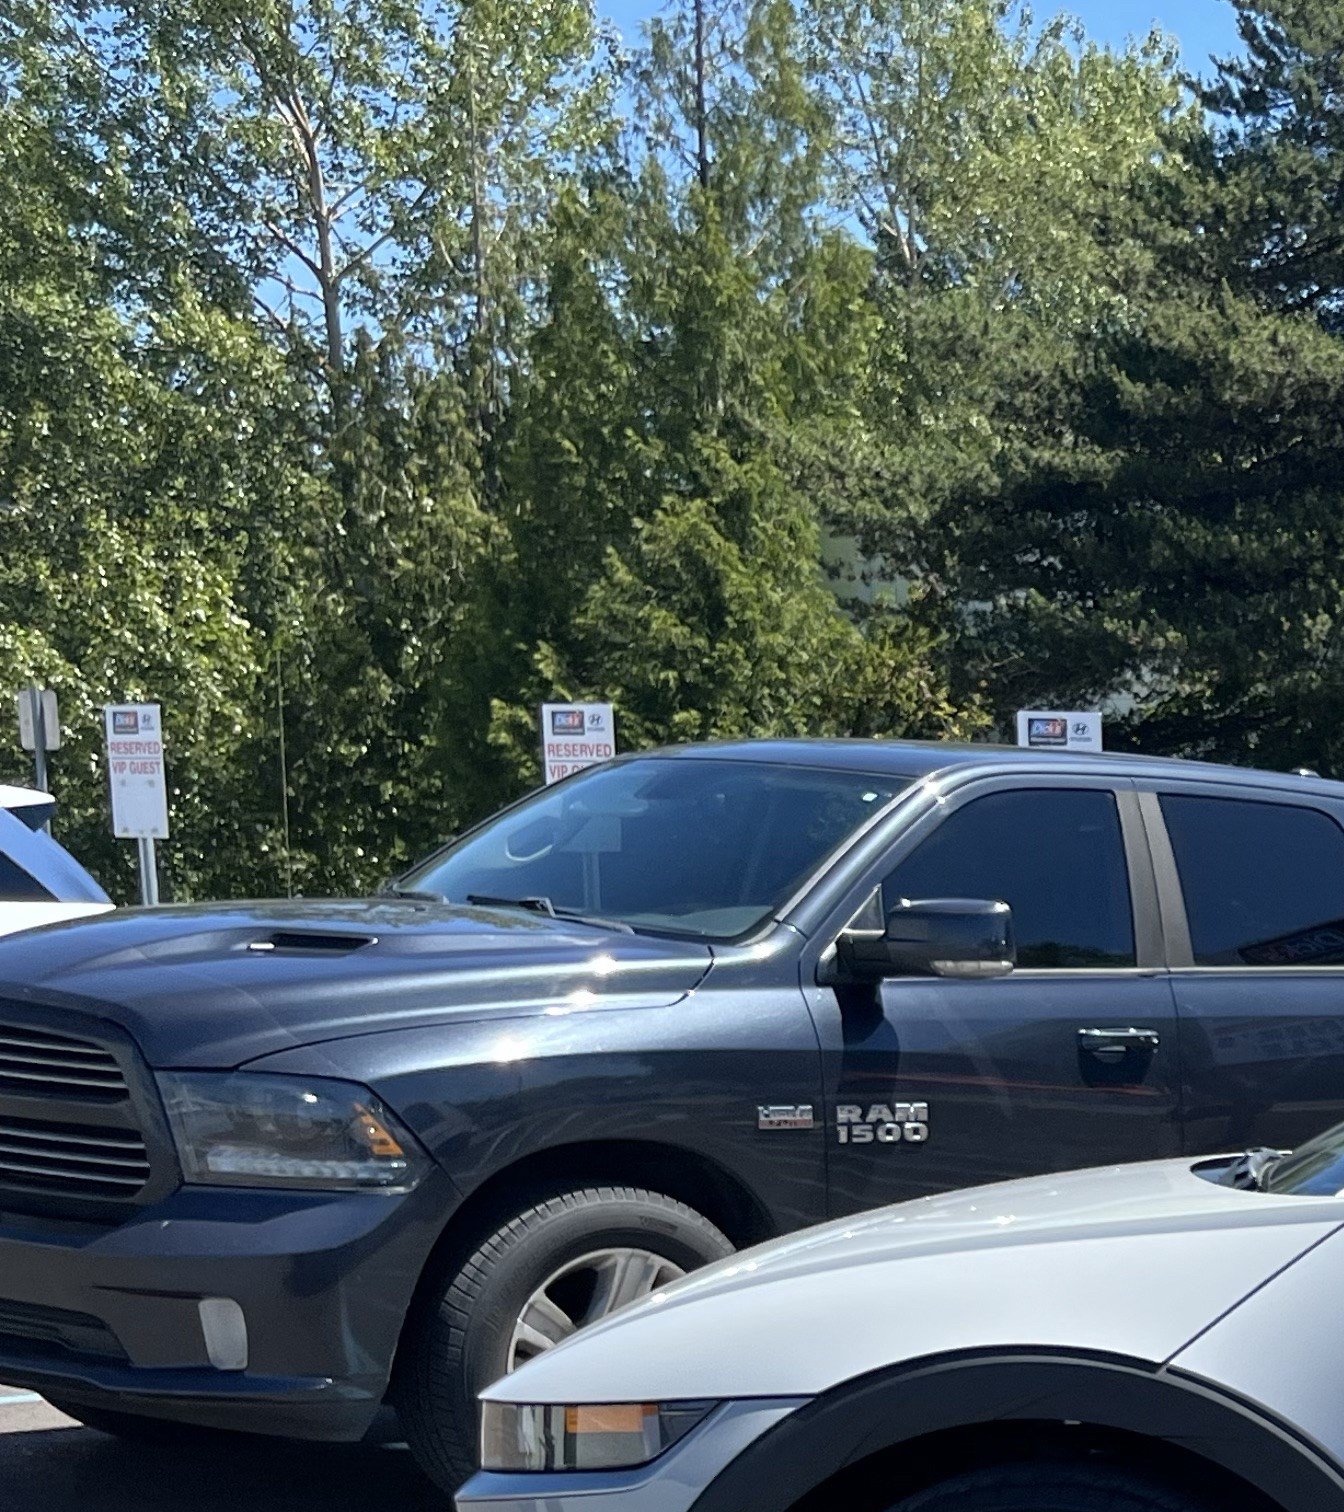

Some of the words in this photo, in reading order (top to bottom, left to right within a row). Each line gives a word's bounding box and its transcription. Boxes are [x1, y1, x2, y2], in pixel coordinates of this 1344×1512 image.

[110, 741, 160, 755] RESERVED
[547, 743, 612, 757] RESERVED
[113, 762, 127, 774] VIP
[130, 762, 160, 774] GUEST
[550, 765, 568, 779] VIP
[836, 1102, 929, 1123] RAM
[836, 1122, 929, 1144] 1500
